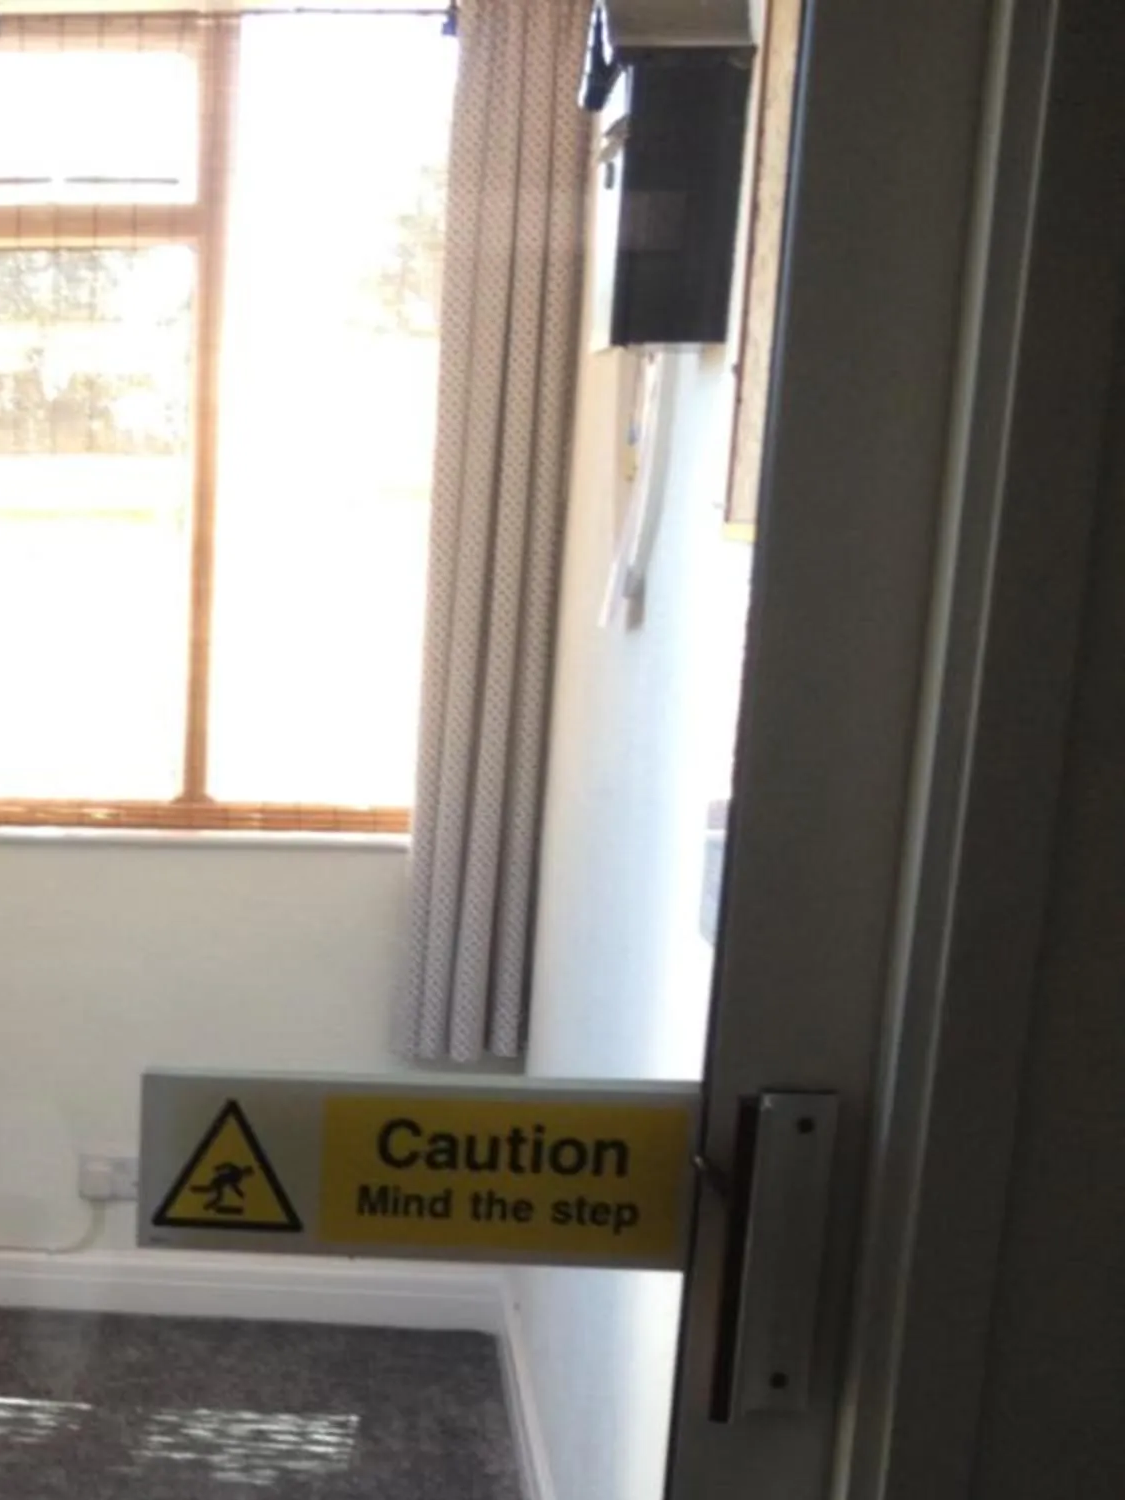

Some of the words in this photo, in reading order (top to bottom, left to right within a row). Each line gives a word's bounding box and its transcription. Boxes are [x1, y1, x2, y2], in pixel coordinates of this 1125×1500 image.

[377, 1118, 628, 1177] Caution
[357, 1184, 452, 1219] Mind
[471, 1190, 534, 1224] the
[551, 1196, 640, 1235] step
